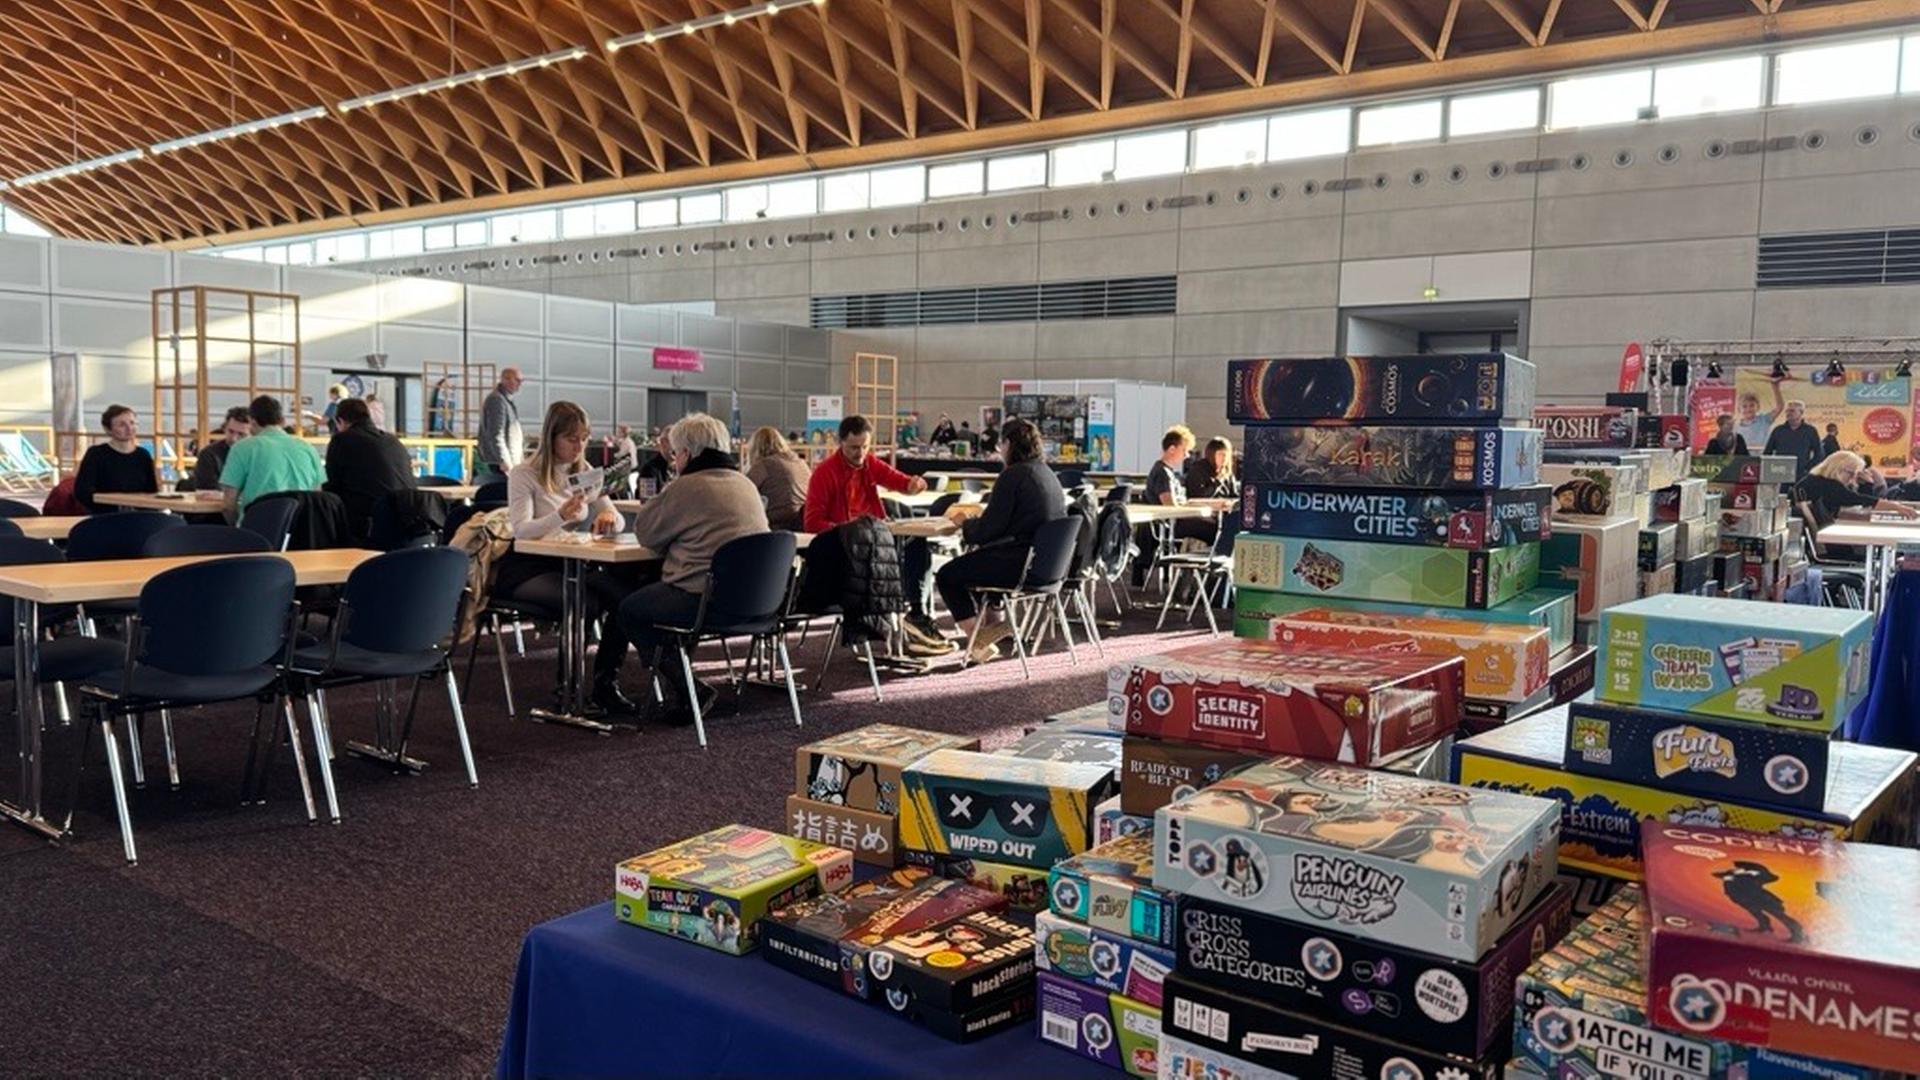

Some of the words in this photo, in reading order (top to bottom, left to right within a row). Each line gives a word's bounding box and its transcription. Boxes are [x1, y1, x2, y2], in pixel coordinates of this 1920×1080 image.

[1386, 363, 1398, 415] COSMOS
[1482, 431, 1496, 486] KOSMOS
[1267, 490, 1407, 516] UNDERWATER
[1354, 514, 1420, 537] CITIES
[1651, 643, 1714, 667] GREEN
[1664, 660, 1700, 676] TEAM
[1653, 670, 1714, 692] WINS
[1198, 697, 1260, 719] SECRET
[1199, 713, 1258, 732] IDENTITY
[1655, 725, 1721, 759] Fun
[1130, 760, 1169, 776] READY
[1169, 766, 1193, 781] SET
[1689, 753, 1736, 771] Facts
[1148, 774, 1172, 788] BET
[788, 808, 889, 856] 指詰め
[1168, 818, 1183, 864] TOPP
[949, 833, 998, 855] WIPED
[1001, 841, 1036, 860] OUT
[1294, 853, 1406, 897] PENGUIN
[650, 889, 674, 901] TEAM
[1299, 882, 1370, 908] AIRLINES
[1184, 909, 1242, 937] CRISS
[1185, 928, 1250, 959] CROSS
[971, 976, 999, 998] black
[999, 959, 1034, 983] stories
[1189, 948, 1307, 990] CATEGORIES
[1436, 974, 1453, 989] DAS
[1417, 989, 1461, 1017] WORTSPIEL
[1603, 1053, 1620, 1070] IF
[1664, 1042, 1704, 1071] ME
